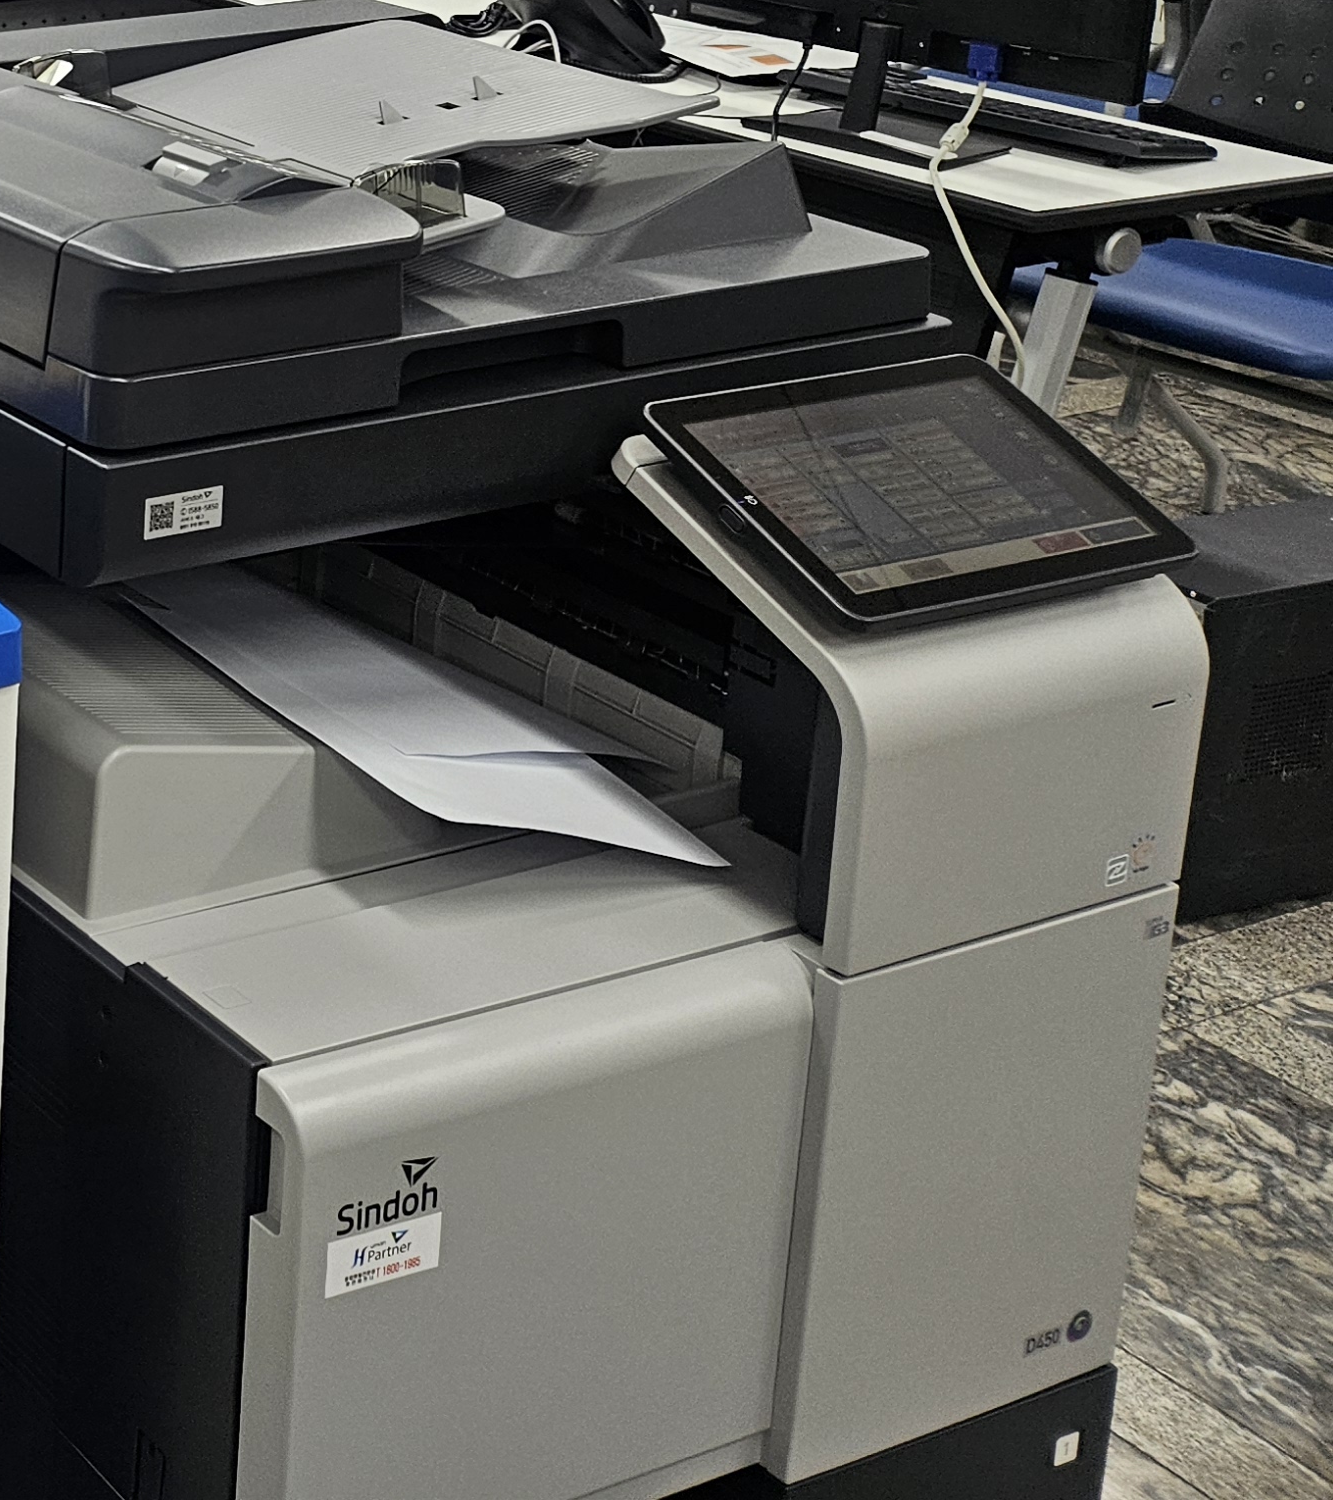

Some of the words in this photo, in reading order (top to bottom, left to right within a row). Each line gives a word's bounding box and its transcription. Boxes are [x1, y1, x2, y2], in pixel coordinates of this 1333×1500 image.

[336, 1182, 438, 1236] Sindoh
[368, 1242, 412, 1262] Partner
[1025, 1328, 1061, 1354] D450
